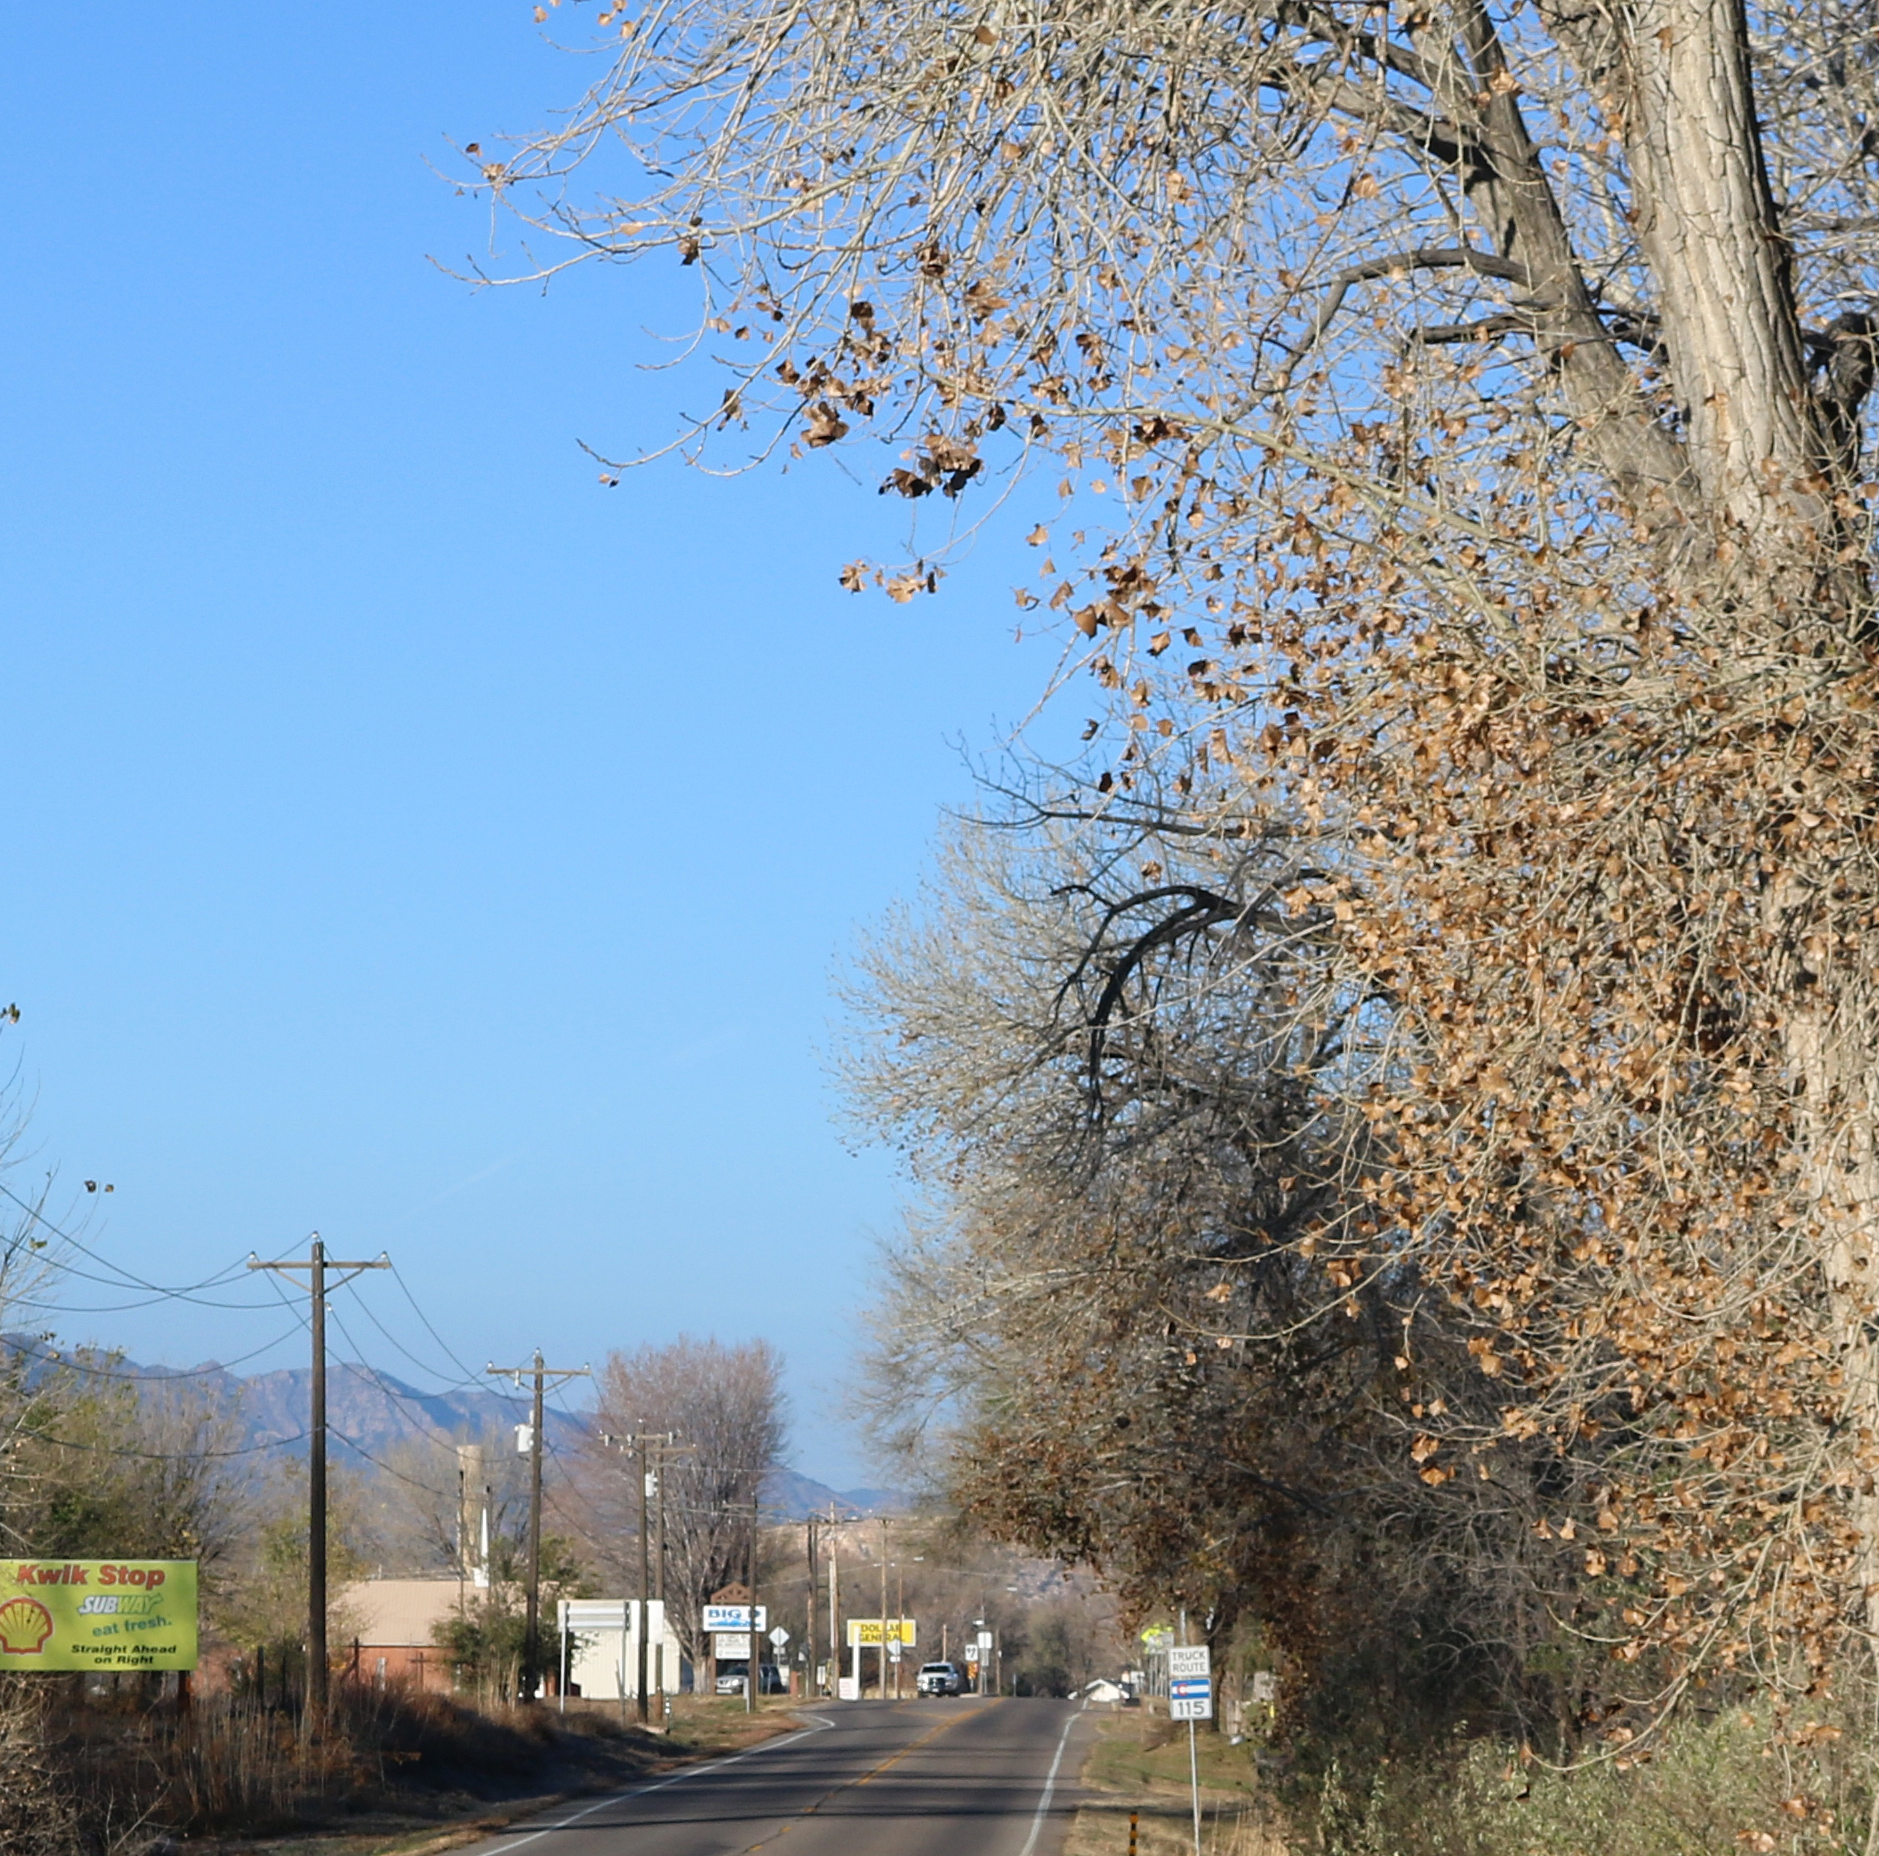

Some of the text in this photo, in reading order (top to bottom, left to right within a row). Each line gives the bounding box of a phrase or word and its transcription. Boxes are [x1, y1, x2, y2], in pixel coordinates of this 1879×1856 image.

[17, 1564, 166, 1591] Kwik Stop
[77, 1593, 163, 1616] SUBWAY
[708, 1609, 742, 1618] BIG
[92, 1623, 119, 1637] eat
[71, 1644, 177, 1656] Straight Ahead
[1172, 1651, 1206, 1661] TRUCK
[94, 1655, 154, 1666] on Right
[1173, 1662, 1206, 1673] ROUTE
[1178, 1701, 1205, 1716] 115
